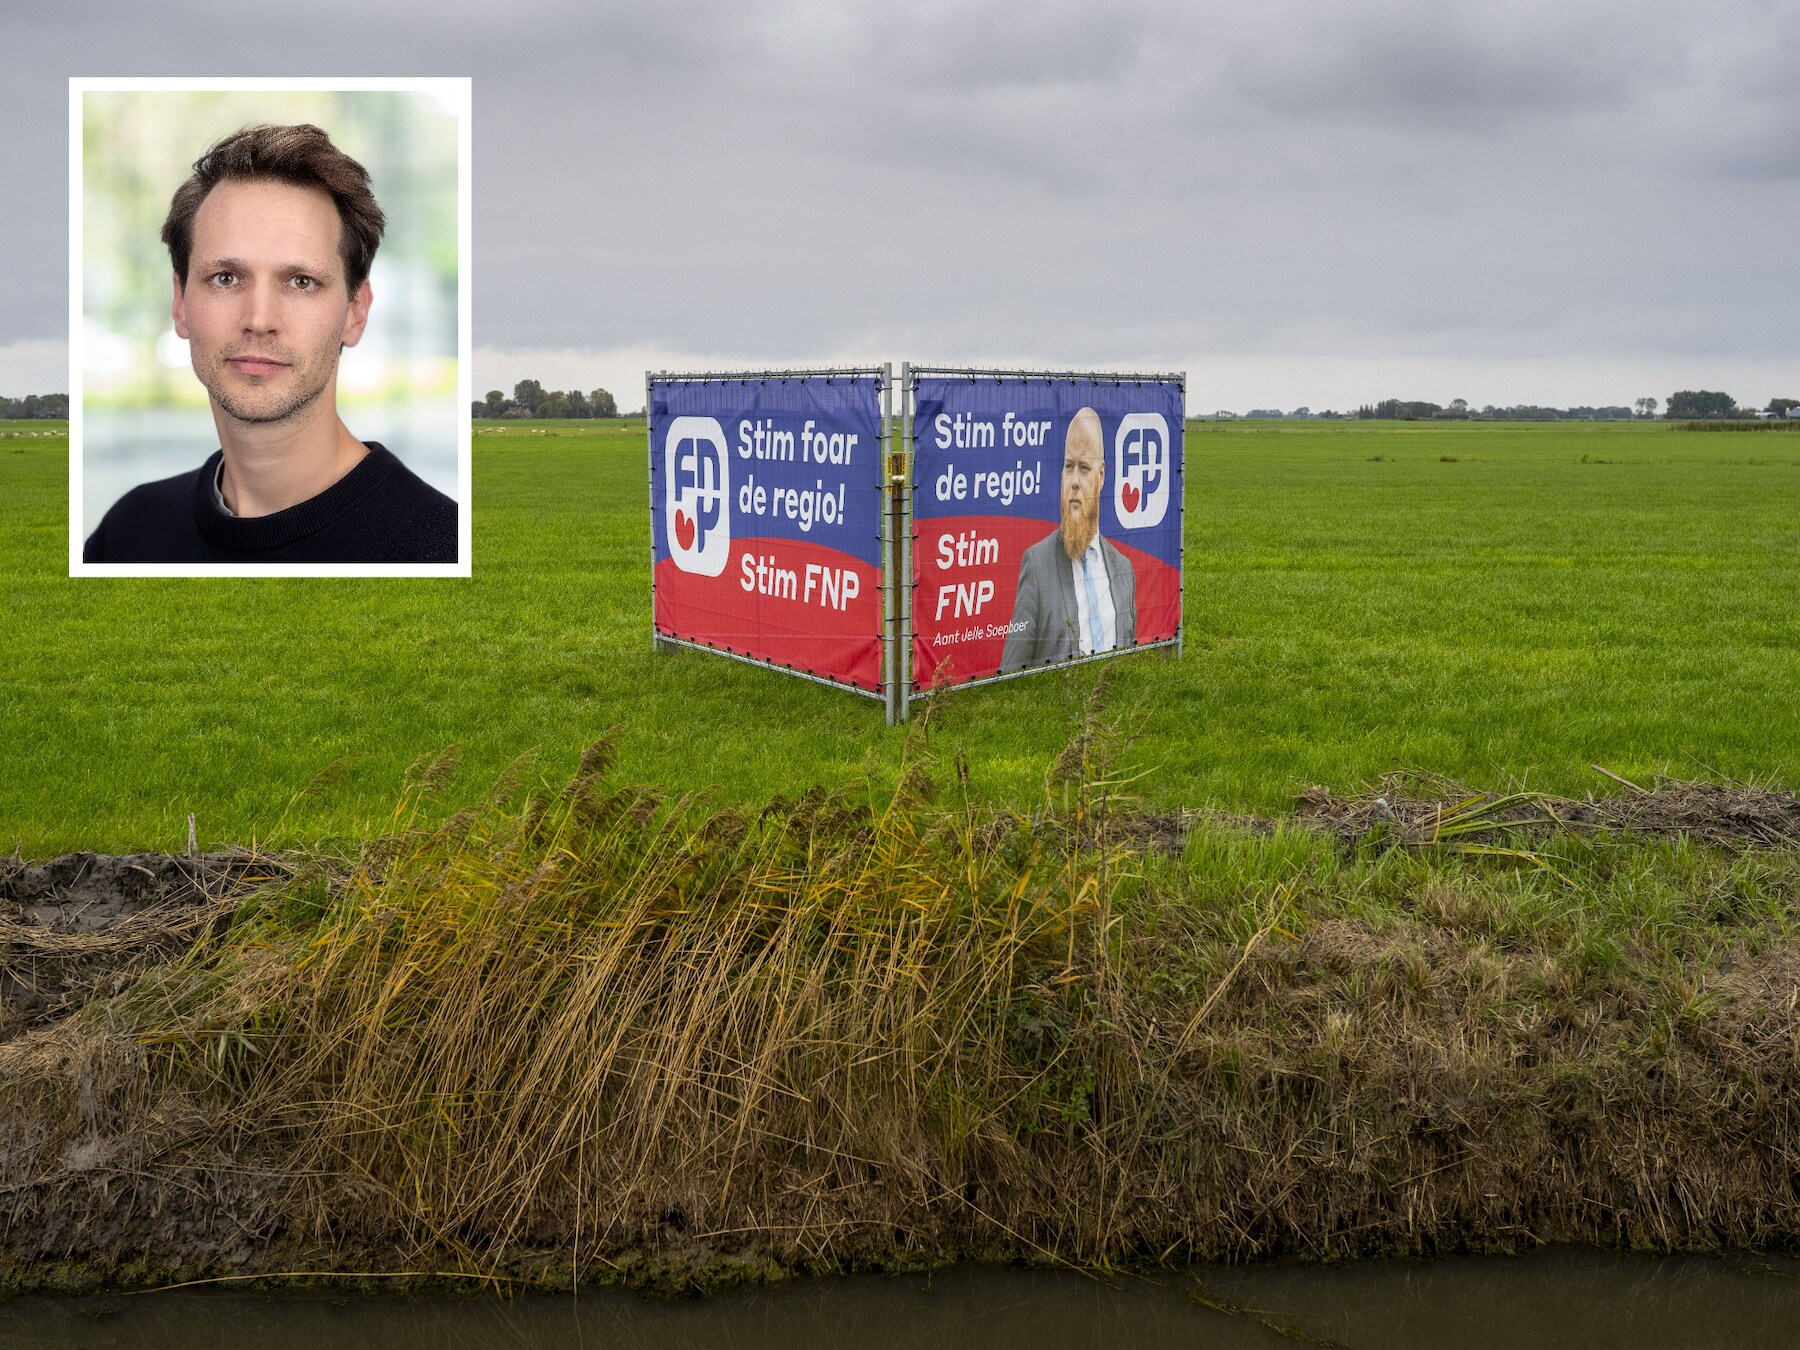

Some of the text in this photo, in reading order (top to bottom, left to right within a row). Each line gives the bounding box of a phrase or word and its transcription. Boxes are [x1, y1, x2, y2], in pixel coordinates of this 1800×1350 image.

[738, 419, 794, 461] Stim
[802, 421, 857, 465] foar
[935, 412, 1051, 449] Stim foar
[739, 475, 845, 532] de regio!
[936, 464, 967, 501] de
[974, 461, 1040, 505] regio!
[936, 530, 998, 569] Stim
[741, 553, 859, 611] Stim FNP
[936, 580, 994, 620] FNP
[933, 620, 1029, 647] Aant Jelle Soepboer
